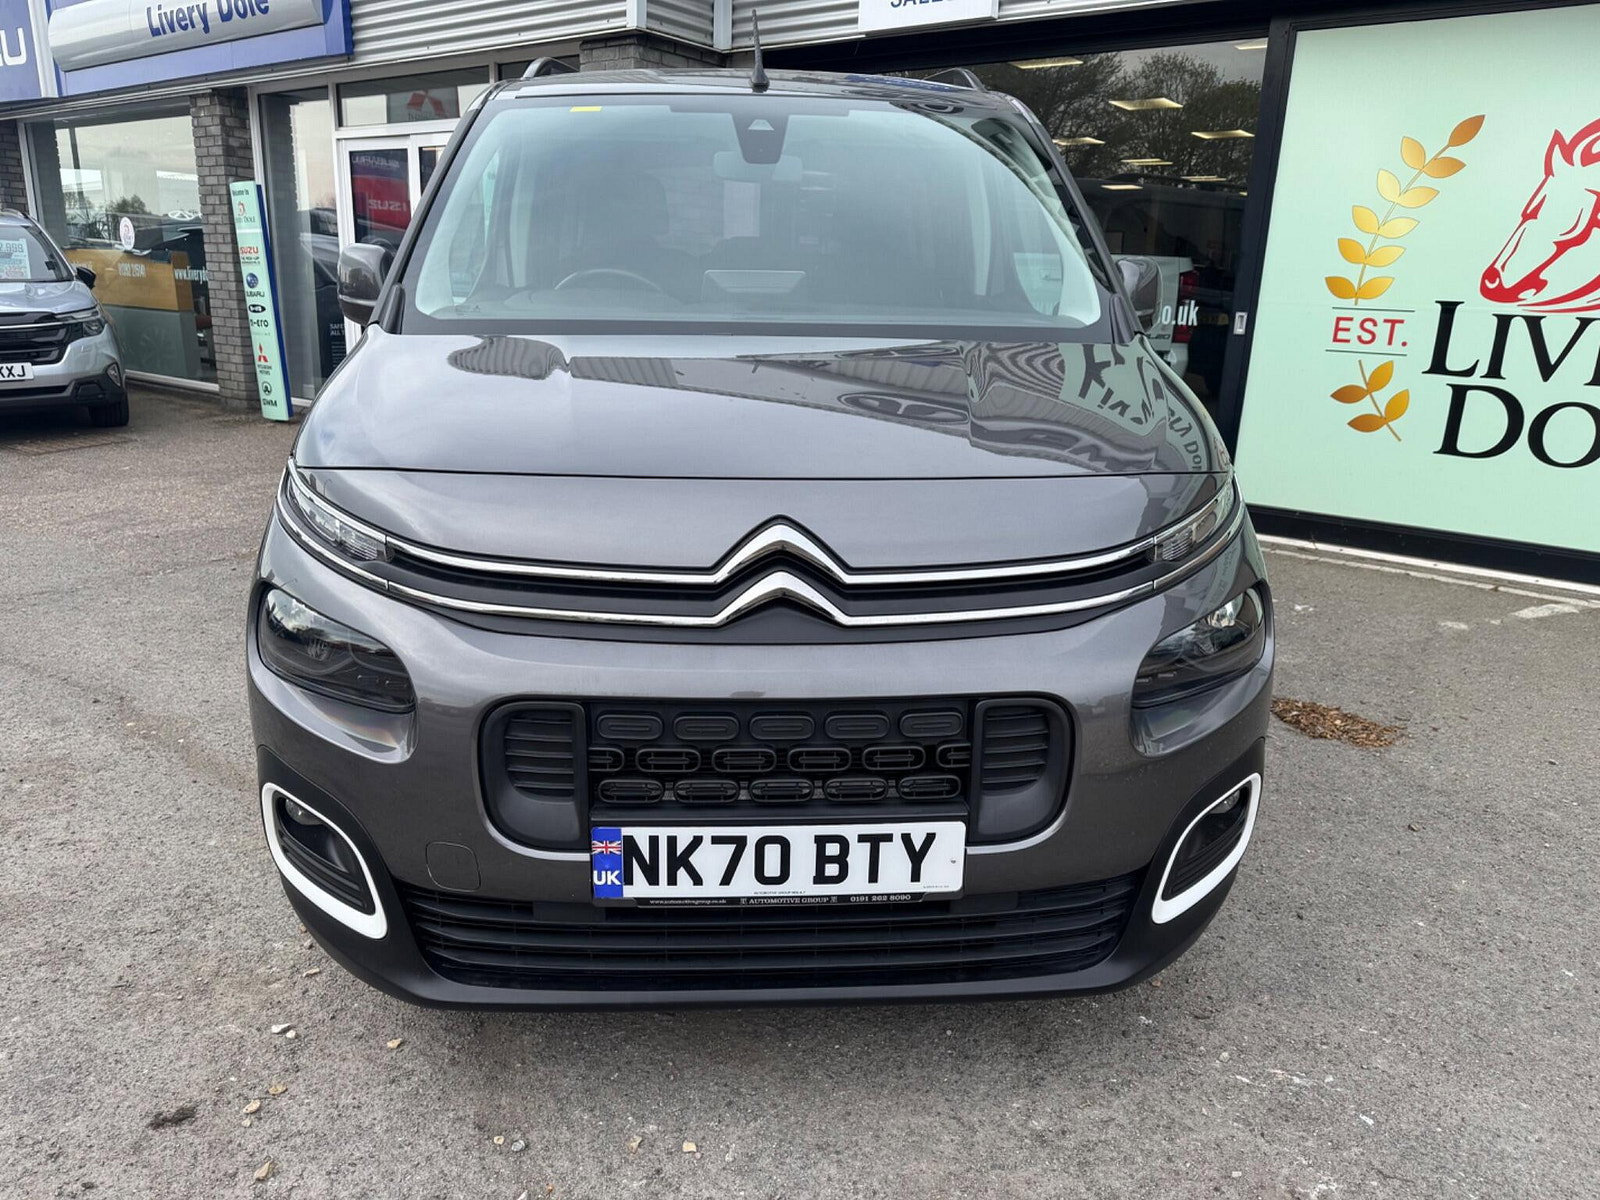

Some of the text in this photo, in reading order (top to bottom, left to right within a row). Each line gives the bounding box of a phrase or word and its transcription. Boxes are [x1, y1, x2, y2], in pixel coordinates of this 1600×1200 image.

[146, 4, 210, 37] Livery
[0, 27, 27, 66] U
[1332, 316, 1408, 347] EST.
[1421, 300, 1600, 387] LIV
[622, 832, 937, 887] NK70 BTY
[593, 870, 621, 886] UK
[749, 897, 800, 905] AUTOMOTIVE
[801, 896, 829, 904] GROUP
